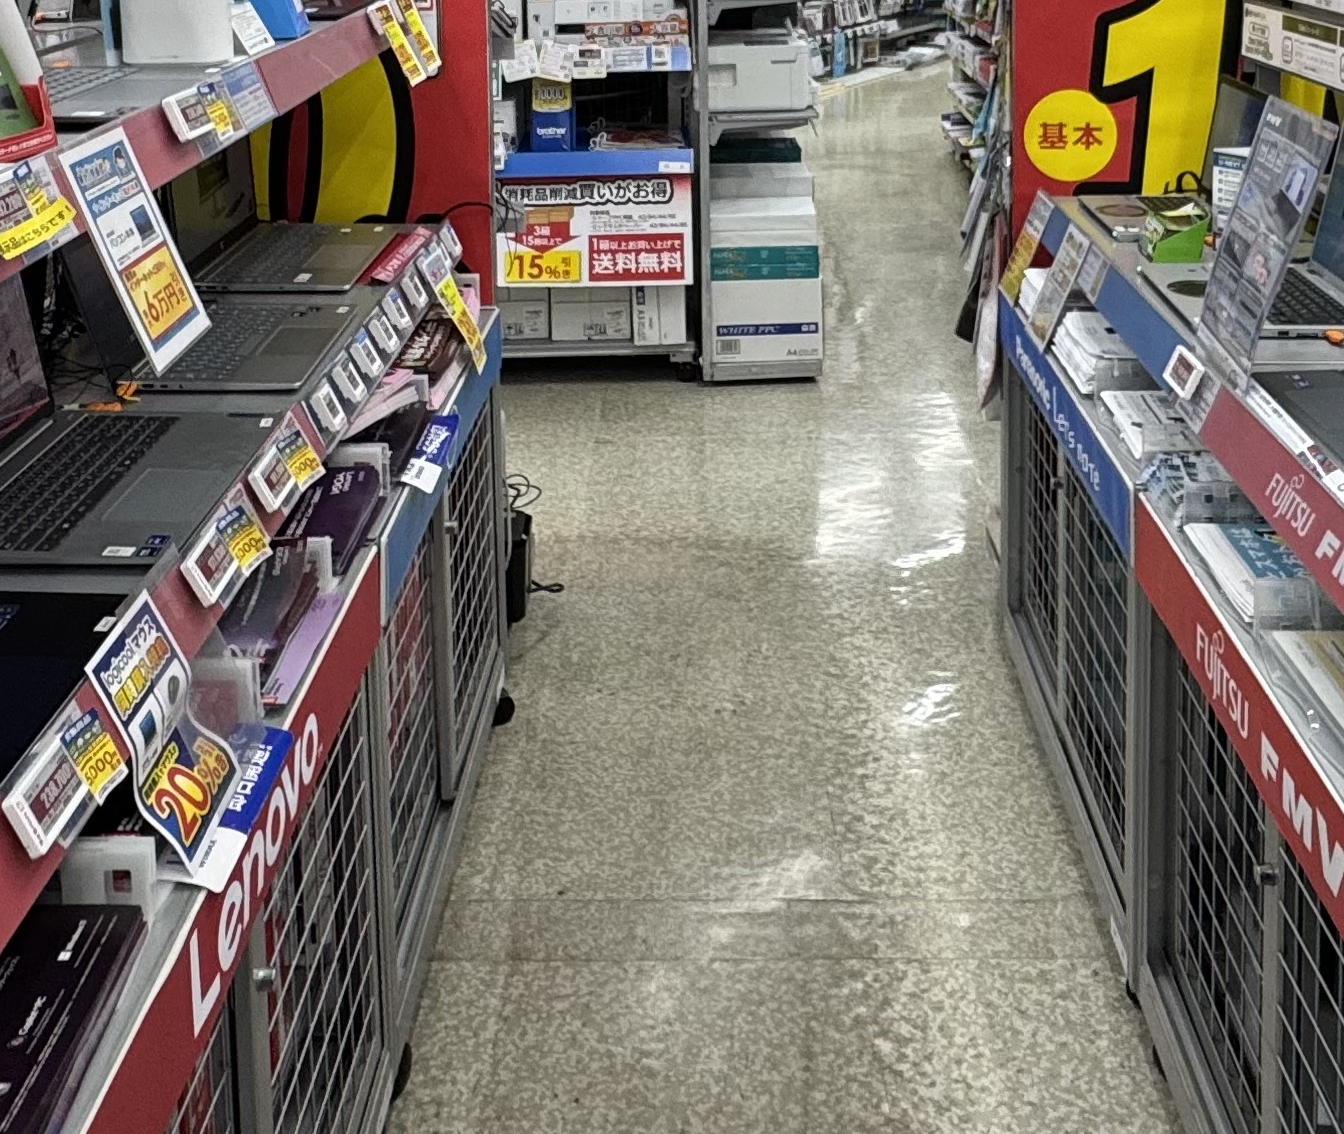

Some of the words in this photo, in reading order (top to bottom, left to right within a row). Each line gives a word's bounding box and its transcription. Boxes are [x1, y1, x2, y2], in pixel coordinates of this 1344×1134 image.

[1038, 121, 1104, 152] 基本
[591, 251, 683, 276] 送料無料
[1263, 469, 1316, 539] FUJITSU
[1194, 622, 1250, 742] FUJITSU
[189, 711, 320, 1041] Lenovo
